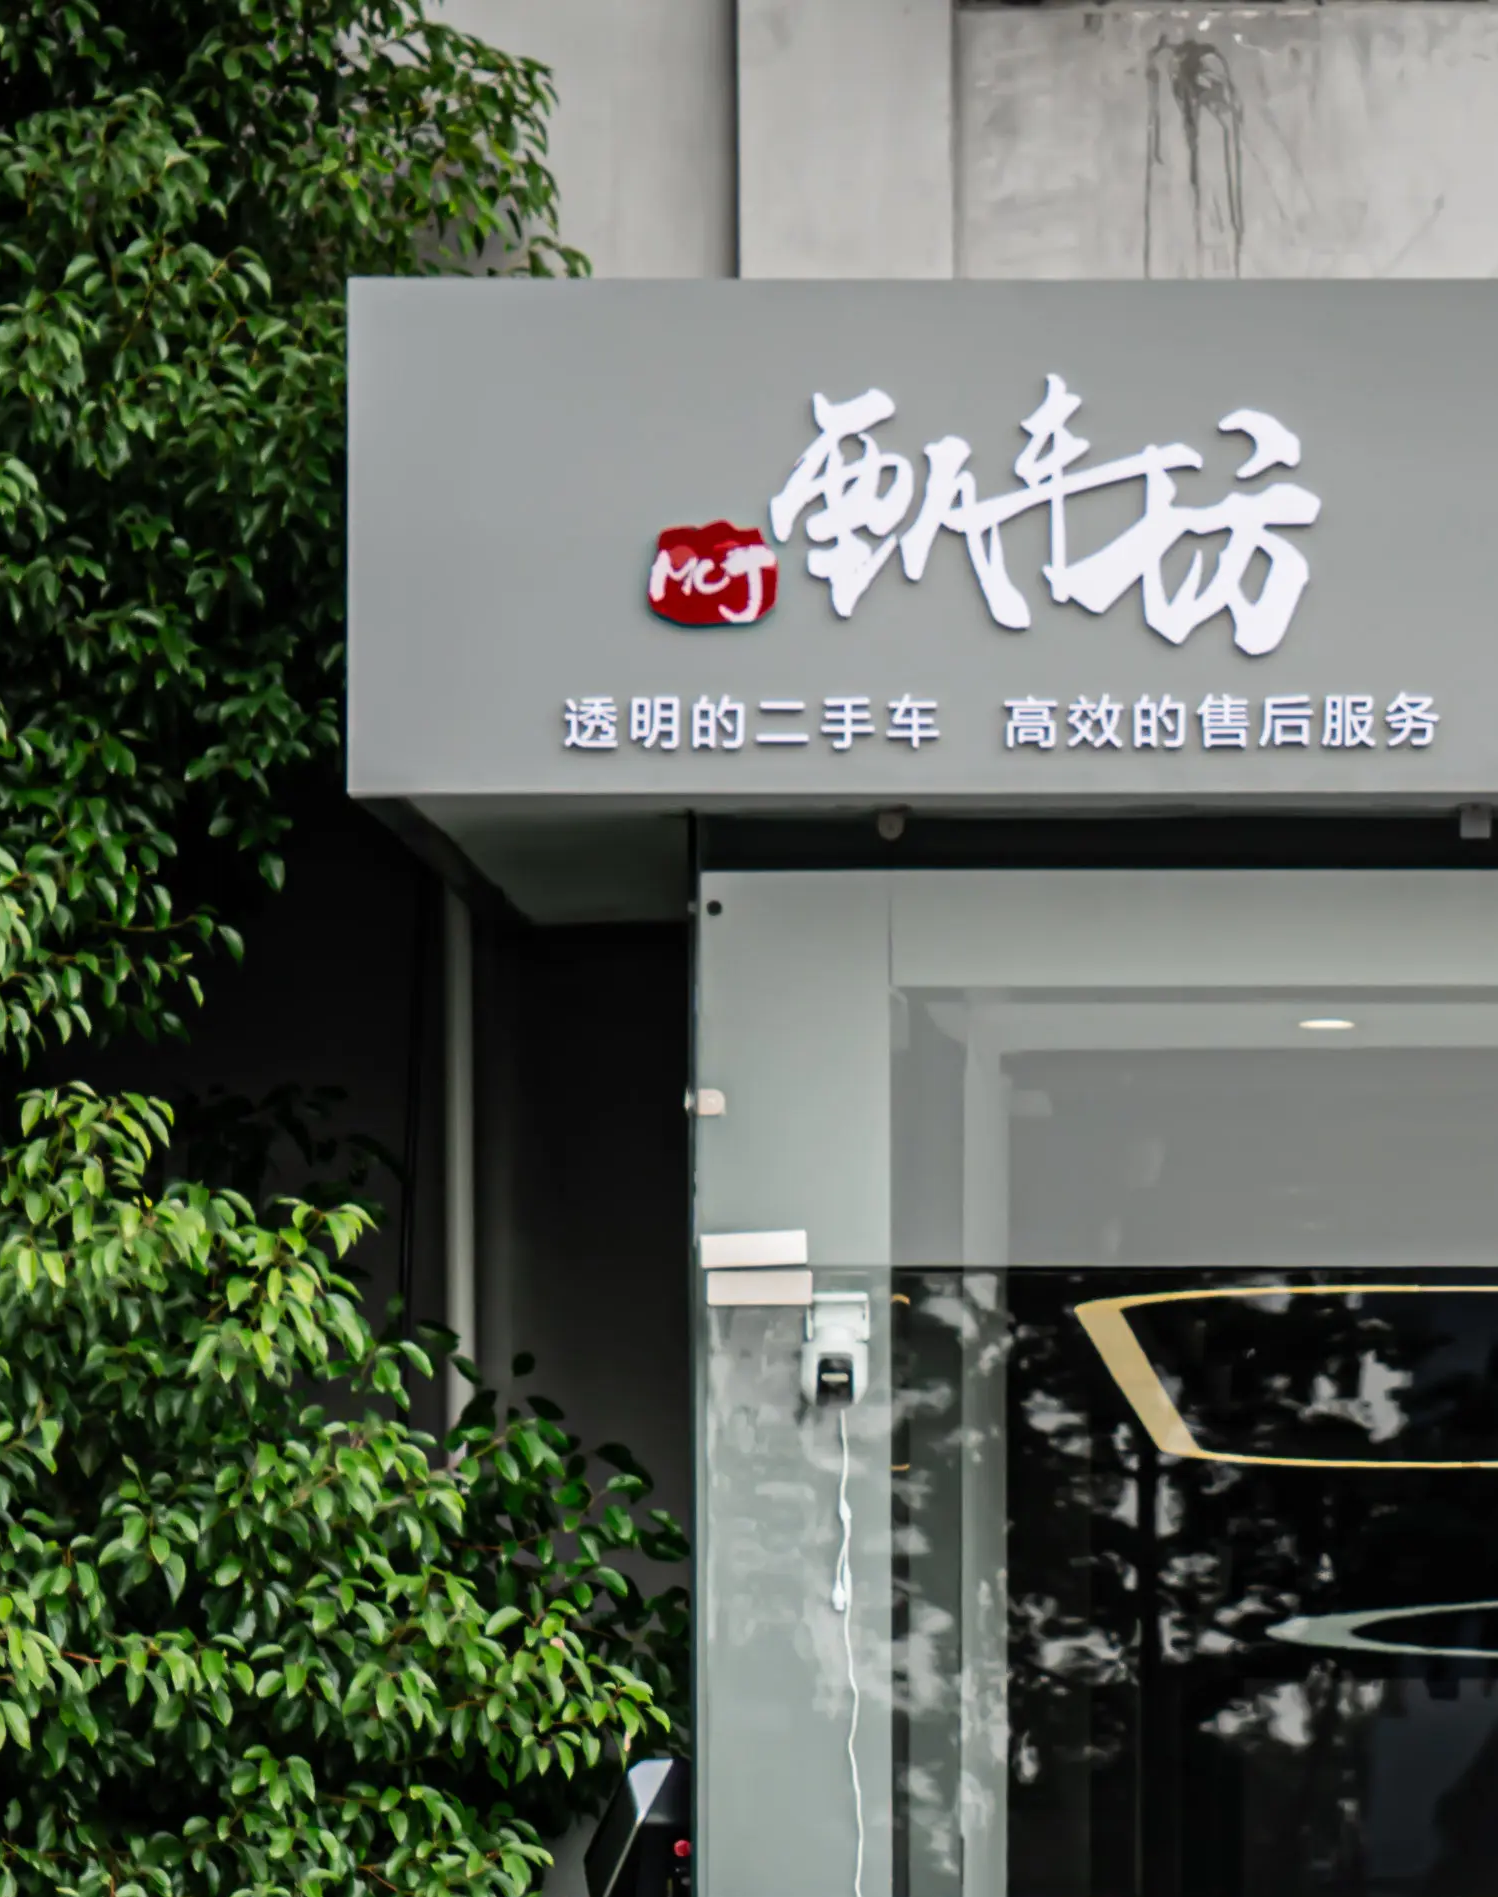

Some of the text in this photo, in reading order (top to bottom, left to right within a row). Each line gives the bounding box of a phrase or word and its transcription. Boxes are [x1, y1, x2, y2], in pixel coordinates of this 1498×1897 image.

[563, 692, 1440, 749] 透明的二手车 高效的售后服务
